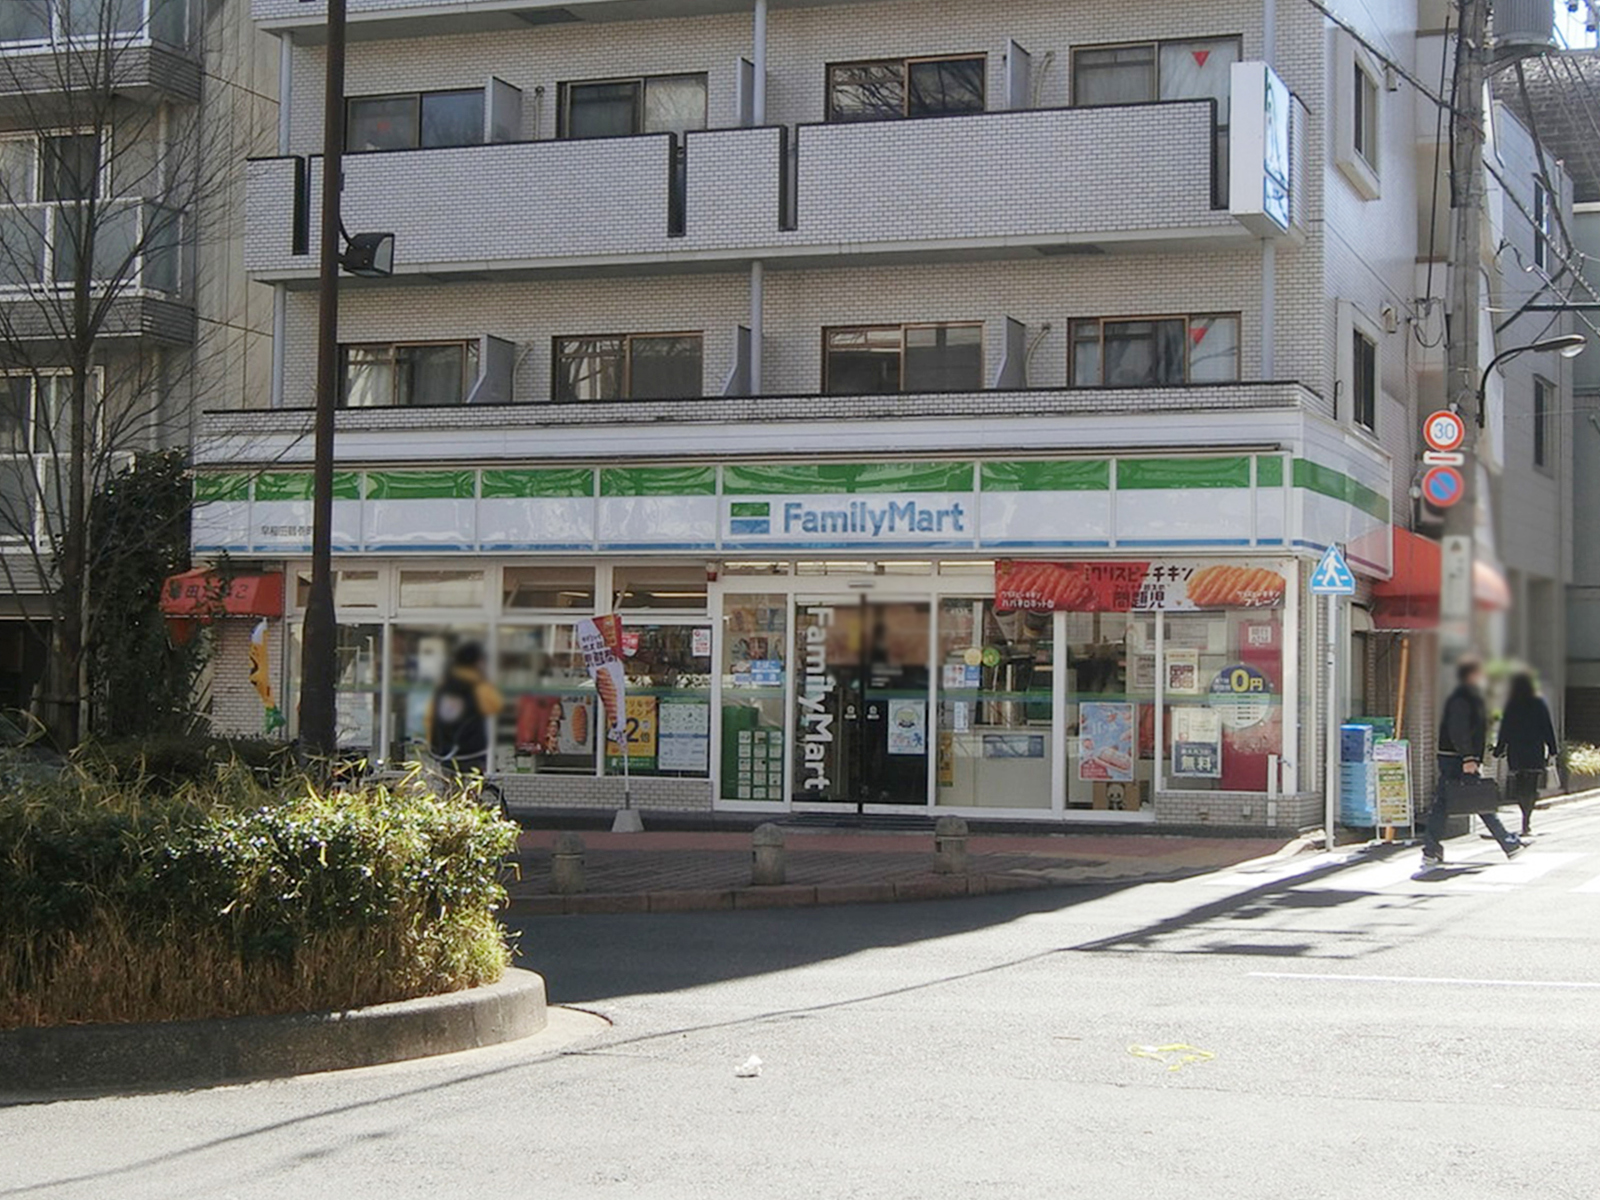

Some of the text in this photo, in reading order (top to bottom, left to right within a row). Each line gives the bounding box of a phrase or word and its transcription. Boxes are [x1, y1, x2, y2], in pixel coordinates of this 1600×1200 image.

[1434, 422, 1455, 440] 30
[783, 501, 964, 537] FamilyMart
[1092, 564, 1194, 582] クリスピーチキン
[1113, 591, 1165, 609] 問題児
[1231, 669, 1263, 692] 0円
[798, 606, 837, 790] FamilyMart
[1181, 755, 1211, 772] 無料
